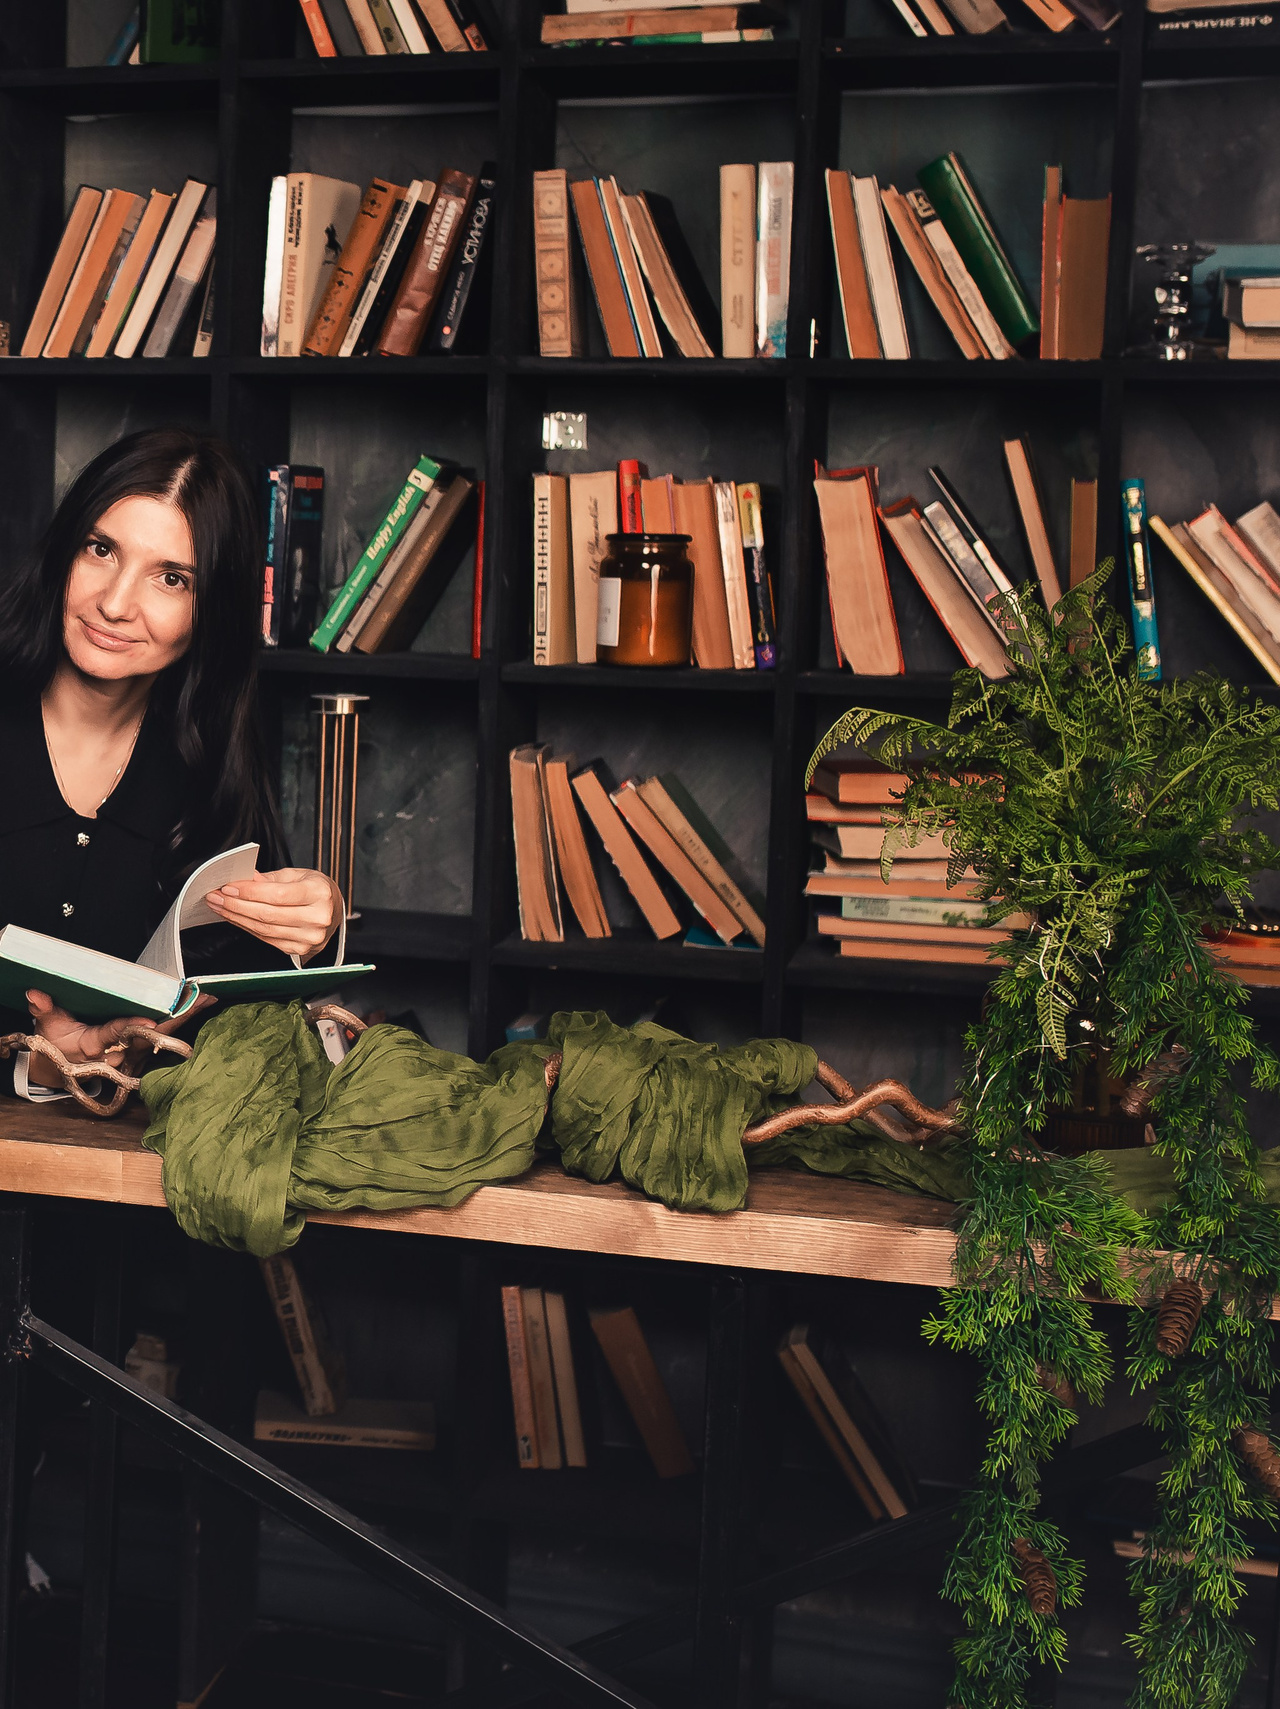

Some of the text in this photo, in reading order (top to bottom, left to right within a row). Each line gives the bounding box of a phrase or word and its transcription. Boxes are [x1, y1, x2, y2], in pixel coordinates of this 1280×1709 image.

[460, 197, 493, 266] УСТИНОВА
[366, 523, 395, 561] Happy
[386, 486, 418, 527] English
